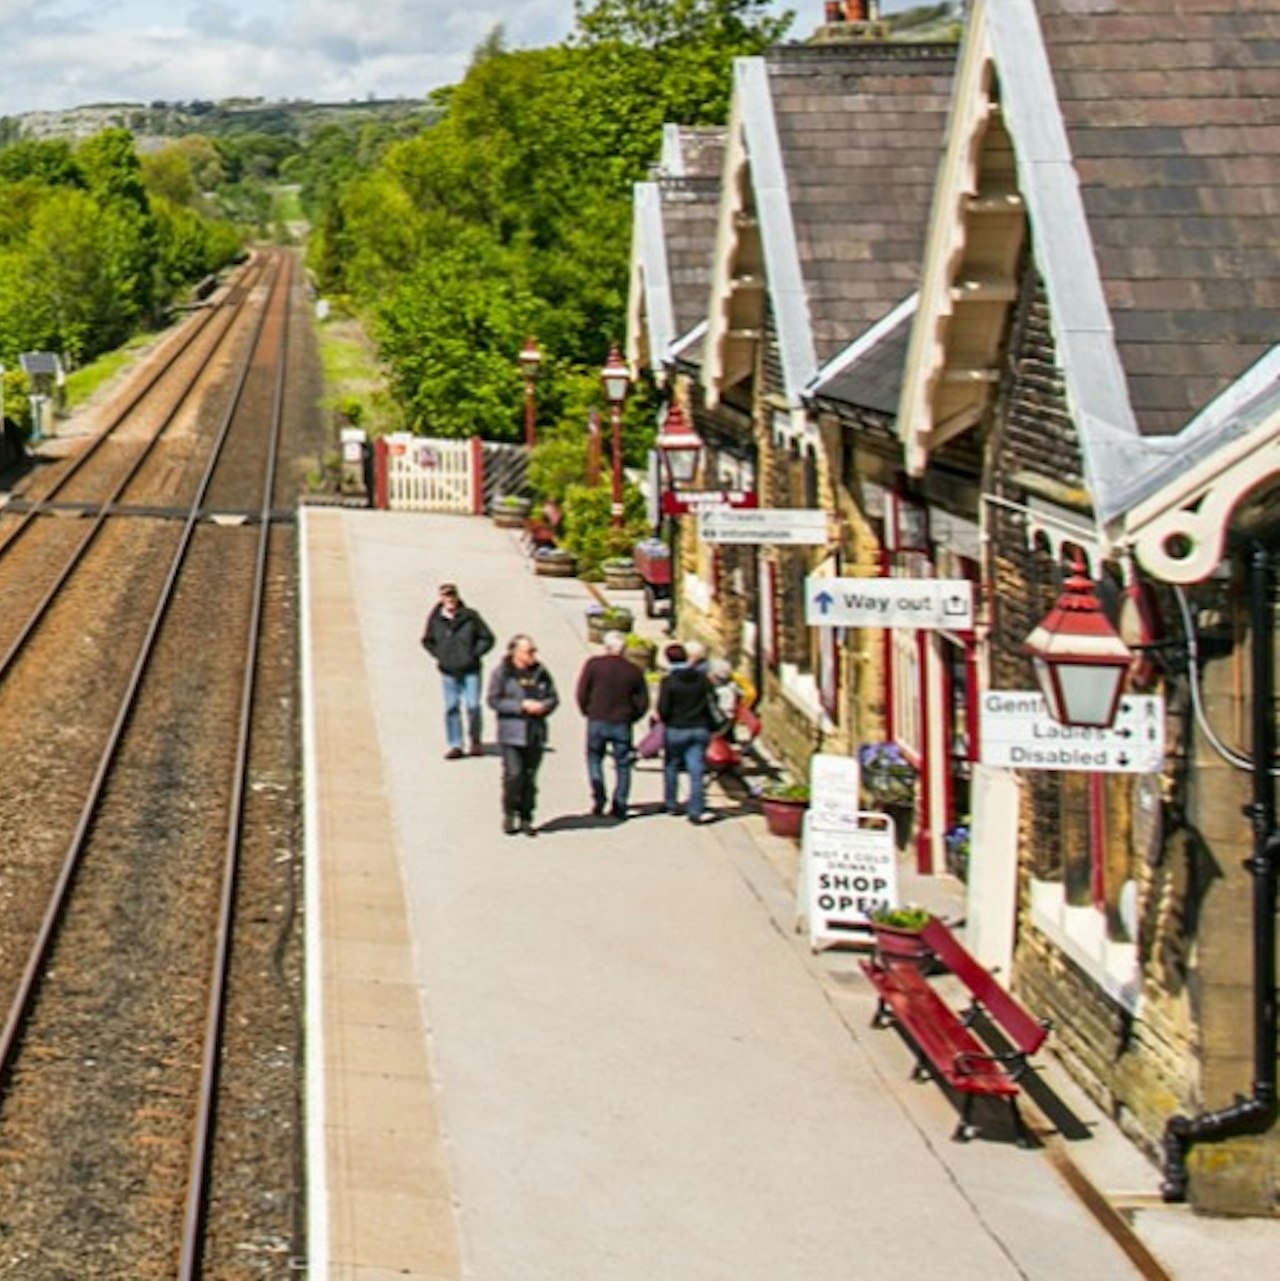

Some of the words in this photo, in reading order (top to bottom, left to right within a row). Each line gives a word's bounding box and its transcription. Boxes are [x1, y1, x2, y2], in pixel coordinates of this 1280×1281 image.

[842, 594, 890, 613] Way
[897, 596, 932, 611] out
[1011, 747, 1107, 766] Disabled
[819, 873, 888, 893] SHOP
[817, 894, 890, 918] OPEN
